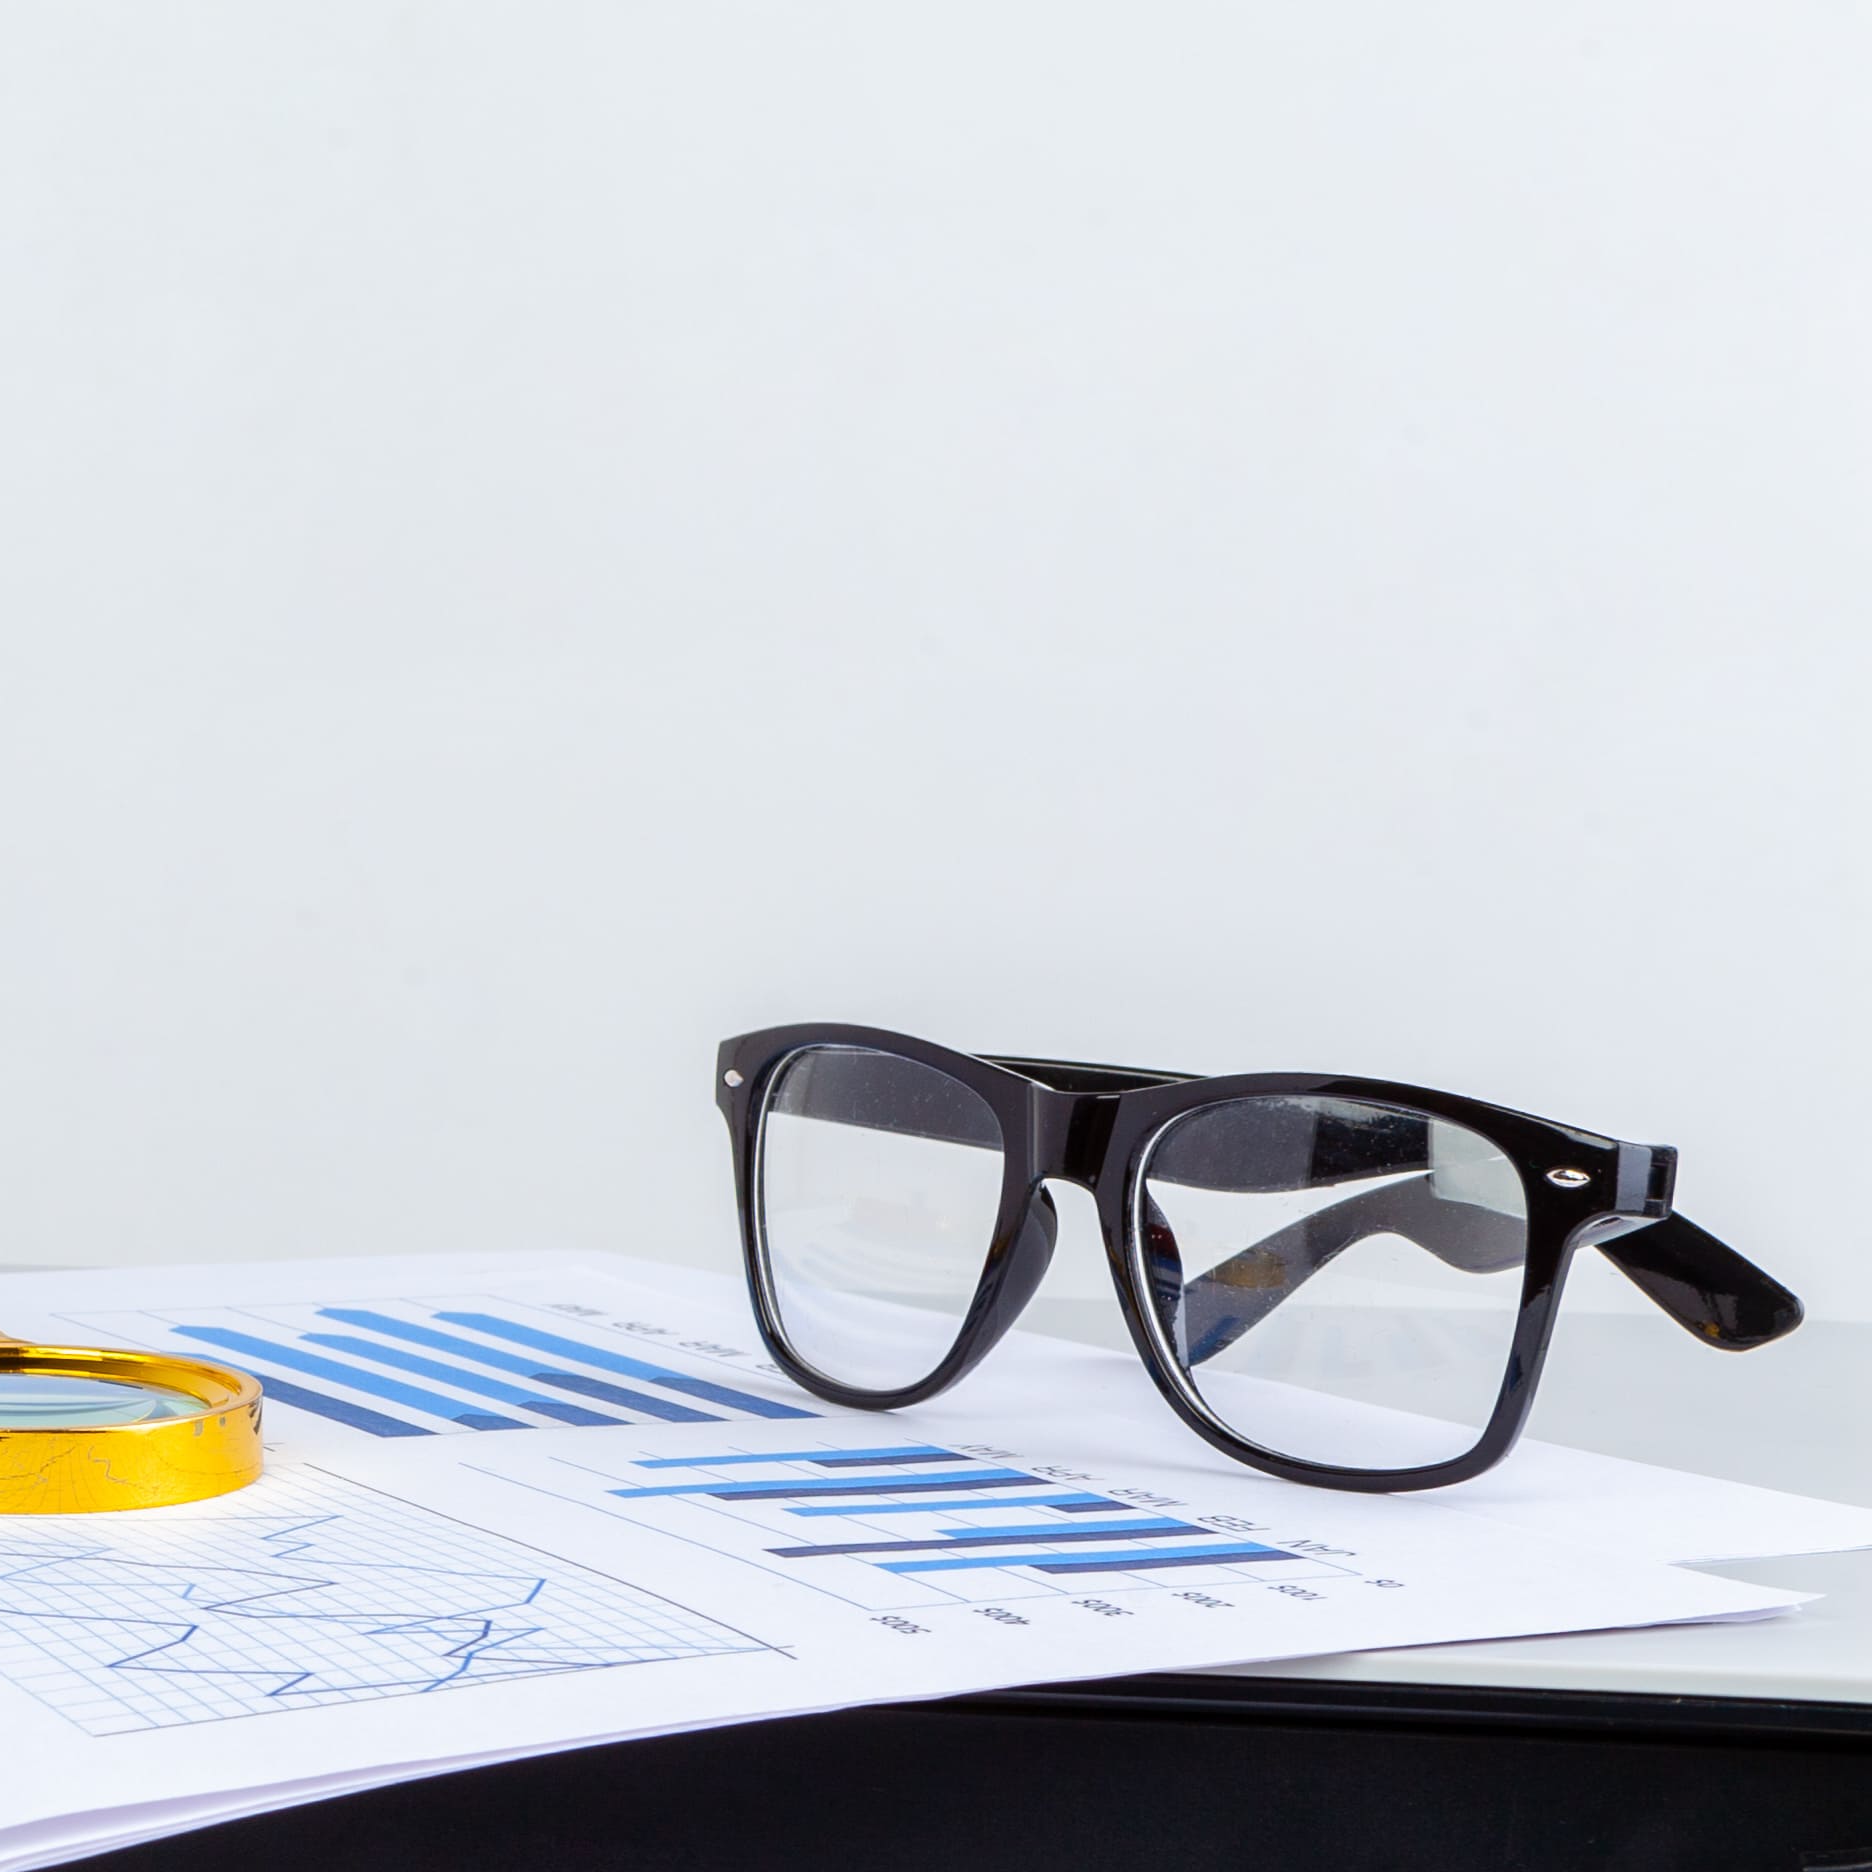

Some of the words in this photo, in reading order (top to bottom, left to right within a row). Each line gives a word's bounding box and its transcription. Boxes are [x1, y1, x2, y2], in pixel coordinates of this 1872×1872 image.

[950, 1444, 1024, 1459] MAY
[1031, 1465, 1105, 1481] APR
[1107, 1488, 1189, 1507] MAR
[1197, 1515, 1272, 1532] FEB
[1276, 1539, 1357, 1557] JAN
